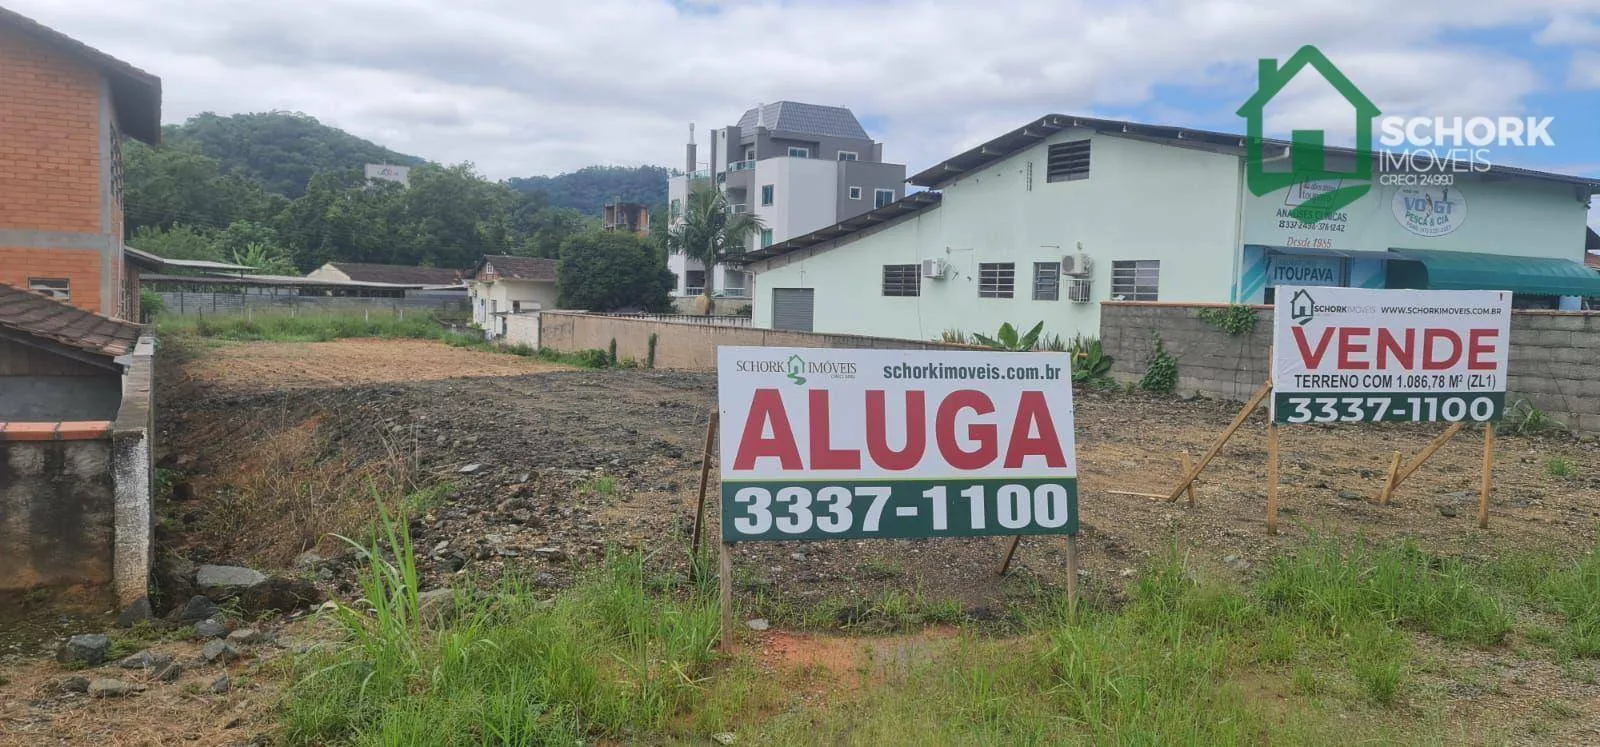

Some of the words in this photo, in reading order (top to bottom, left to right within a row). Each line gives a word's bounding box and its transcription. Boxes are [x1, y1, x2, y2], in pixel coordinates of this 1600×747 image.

[1273, 265, 1334, 281] ITOUPAVA
[1381, 306, 1502, 315] WWW.SCHORKIMOVEIS.COM.BR
[1291, 326, 1499, 370] VENDE
[736, 360, 786, 374] SCHORK
[883, 362, 1062, 380] schorkimoveis.com.br
[1294, 374, 1359, 389] TERRENO
[1362, 374, 1393, 389] COM
[1396, 374, 1445, 390] 1.086,78
[1467, 374, 1496, 390] (ZL1)
[1287, 396, 1495, 423] 3337-1100
[732, 387, 1068, 471] ALUGA
[734, 483, 1068, 536] 3337-1100
